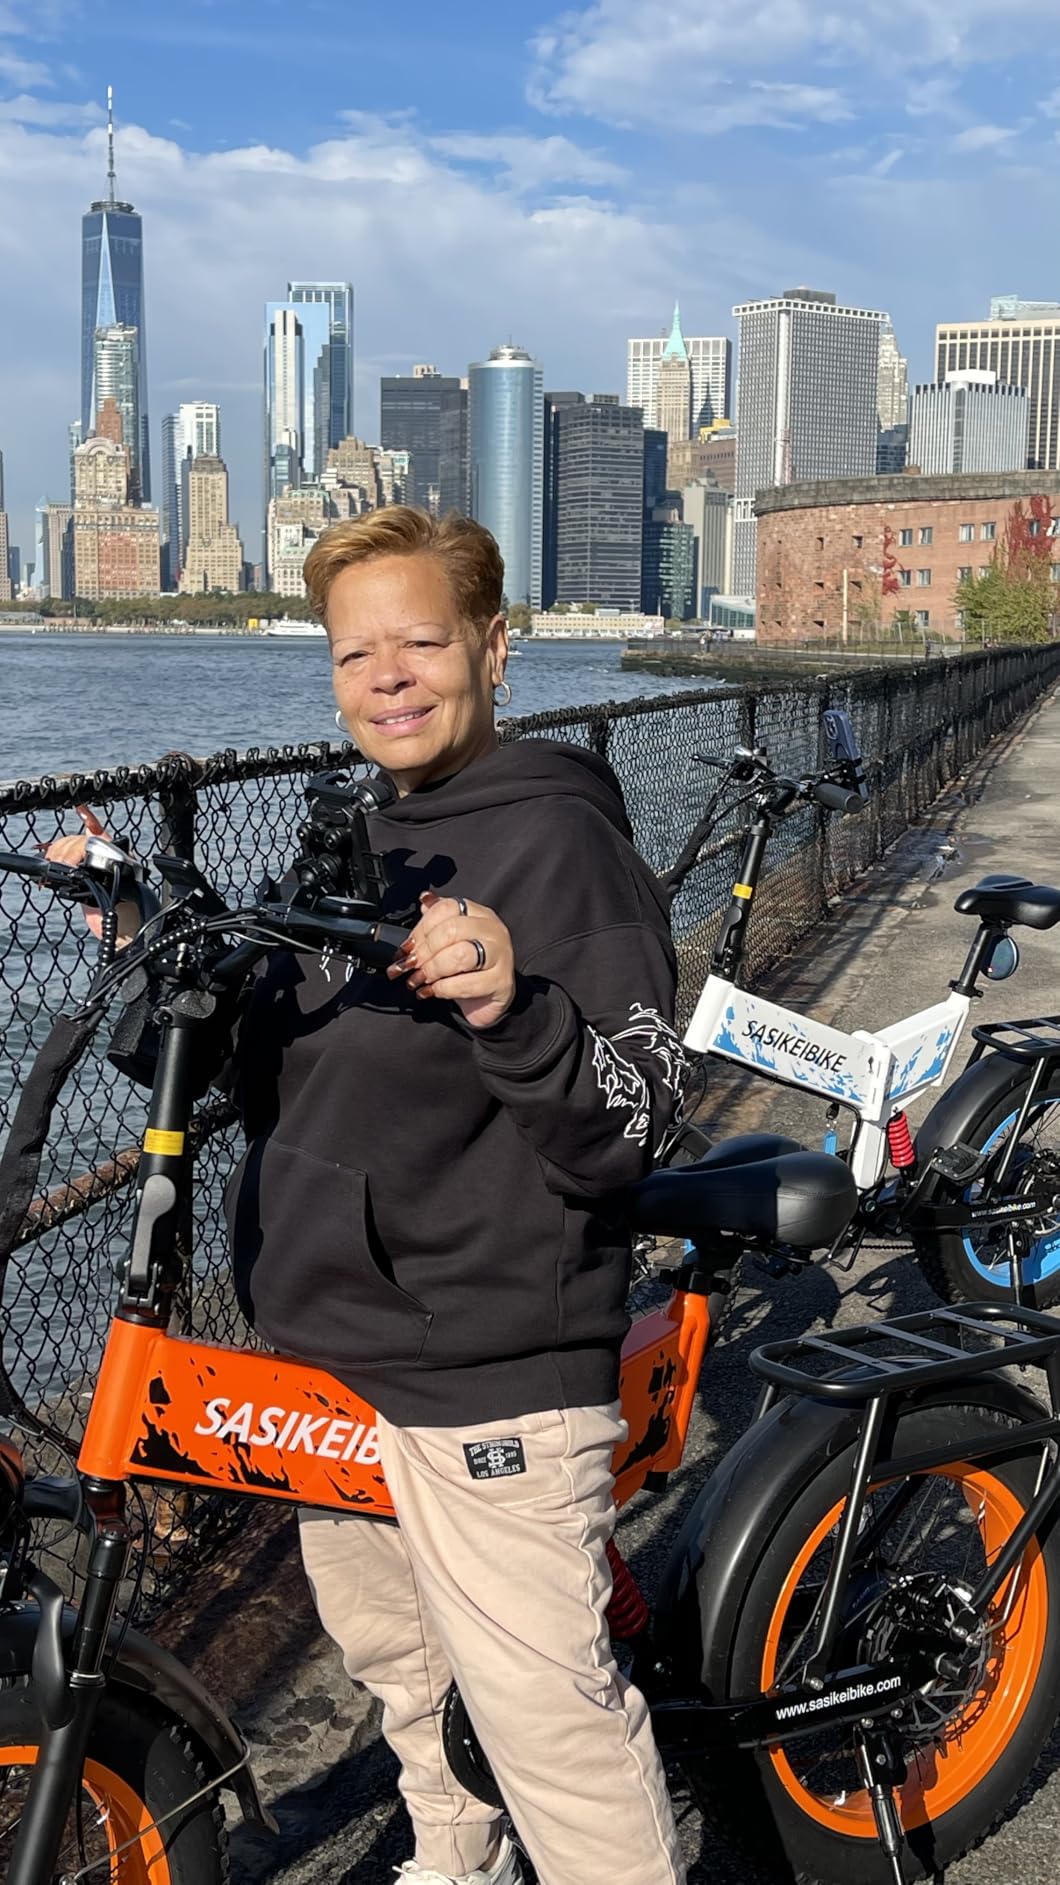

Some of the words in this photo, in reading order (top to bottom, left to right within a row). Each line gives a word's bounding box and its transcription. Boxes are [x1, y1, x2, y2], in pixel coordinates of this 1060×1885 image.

[741, 1020, 847, 1073] SASIKEIBIKE
[476, 1469, 490, 1478] LOS
[490, 1463, 521, 1476] ANGELES
[775, 1675, 902, 1720] www.sasikeibike.com
